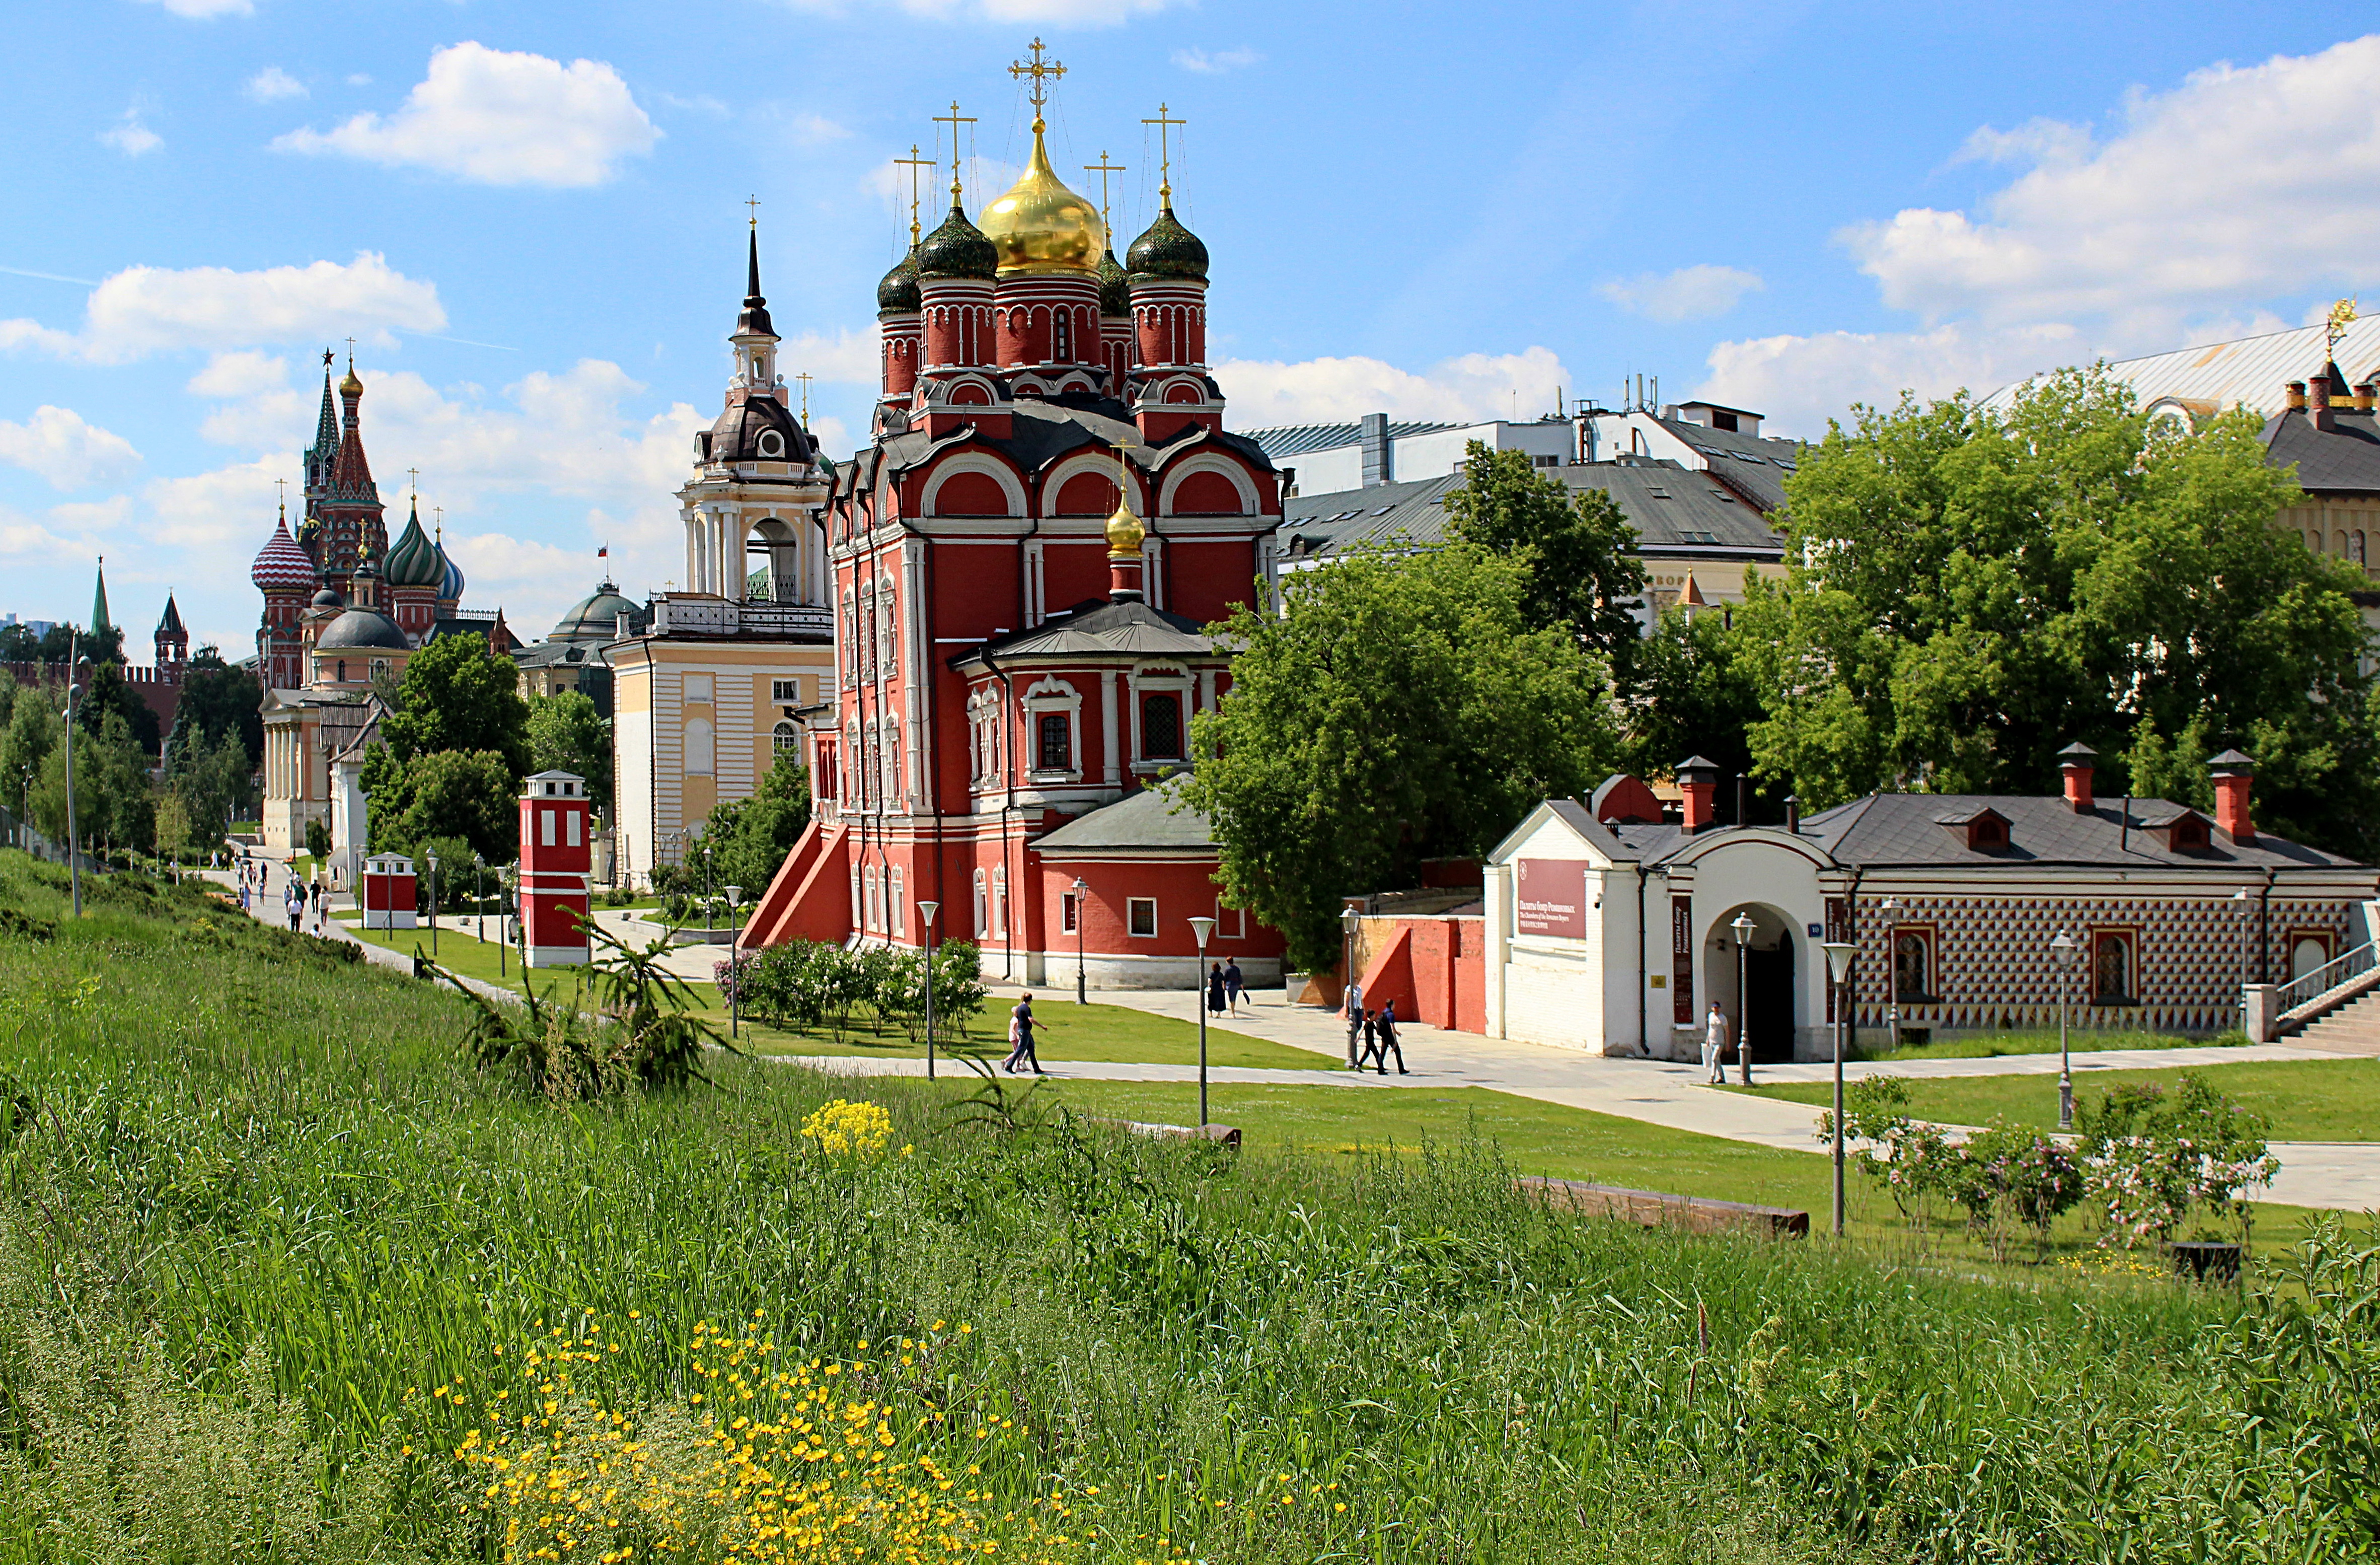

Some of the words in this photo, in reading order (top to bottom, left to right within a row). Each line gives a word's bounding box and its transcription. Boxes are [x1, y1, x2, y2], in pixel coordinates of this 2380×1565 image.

[1645, 576, 1684, 585] ВОР
[1520, 900, 1536, 910] Палаты
[1537, 900, 1547, 913] бояр
[1548, 901, 1575, 913] Романовых
